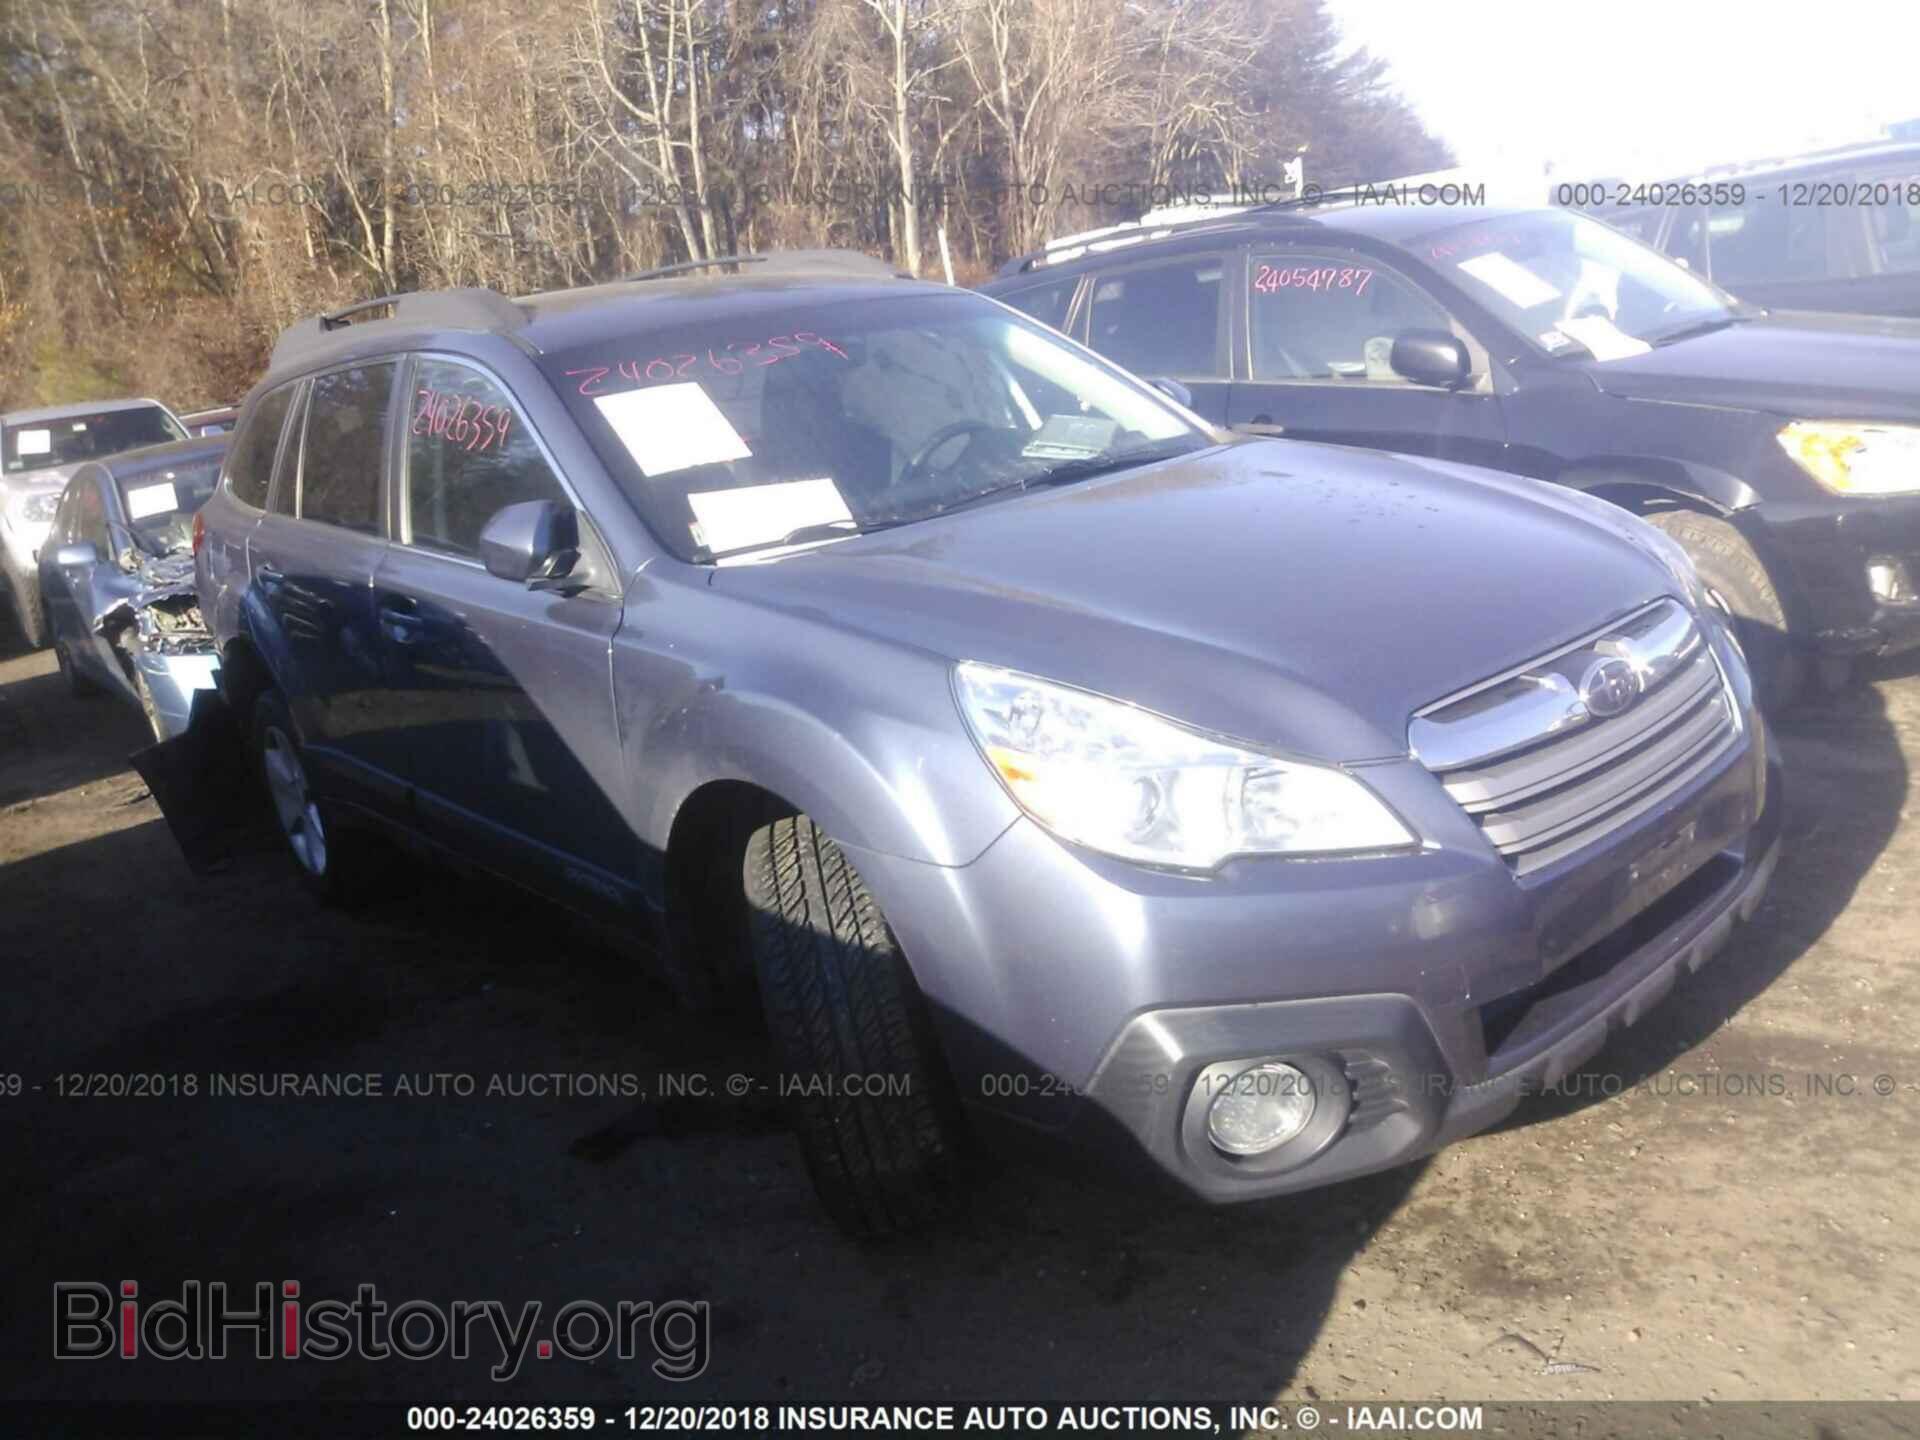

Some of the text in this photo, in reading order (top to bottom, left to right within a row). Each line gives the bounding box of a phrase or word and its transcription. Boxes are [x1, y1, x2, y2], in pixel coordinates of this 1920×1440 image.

[1255, 265, 1373, 295] 24054787
[565, 332, 848, 396] 24026359
[412, 390, 511, 450] 24026359
